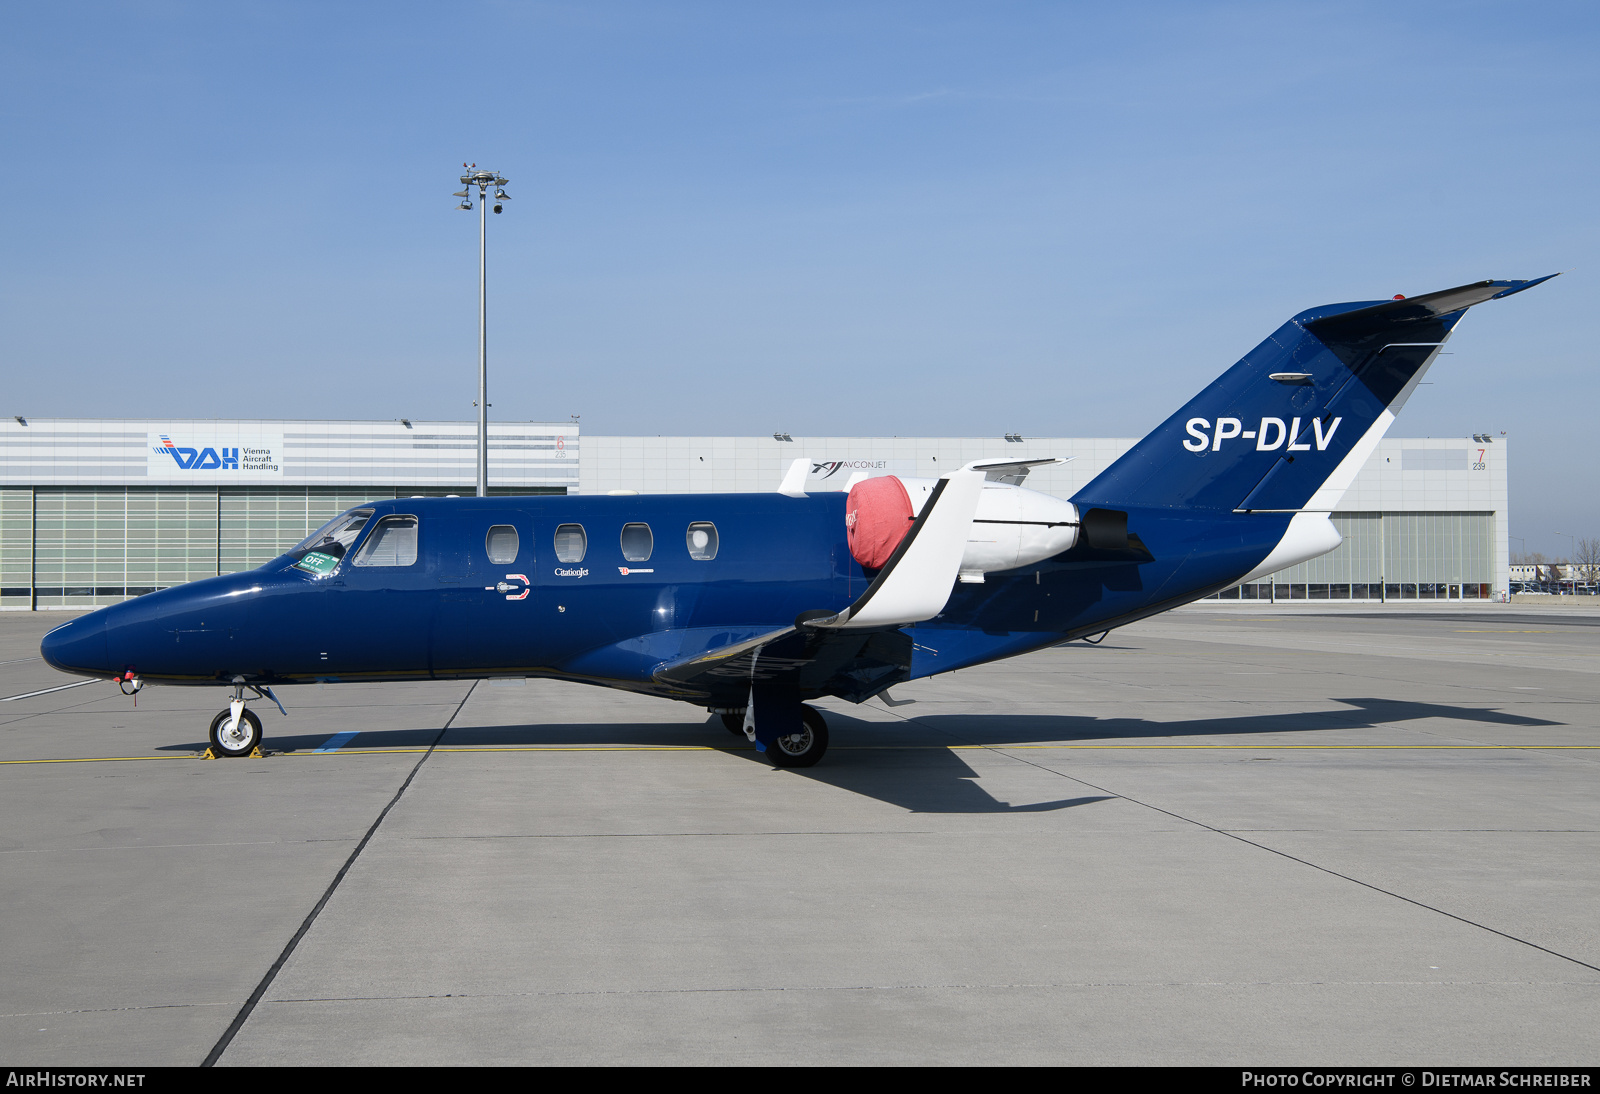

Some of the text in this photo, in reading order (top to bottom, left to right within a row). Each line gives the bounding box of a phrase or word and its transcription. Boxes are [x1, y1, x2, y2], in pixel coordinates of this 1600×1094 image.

[1182, 417, 1343, 452] SP-DLV
[556, 435, 565, 450] 6
[242, 447, 271, 455] Vienna
[1477, 448, 1486, 463] 7
[242, 455, 272, 463] Aircraft
[242, 463, 279, 472] Handling
[842, 460, 887, 469] AVCONJET
[1472, 462, 1486, 471] 239
[304, 555, 325, 566] OFF
[554, 567, 589, 579] CitationJet
